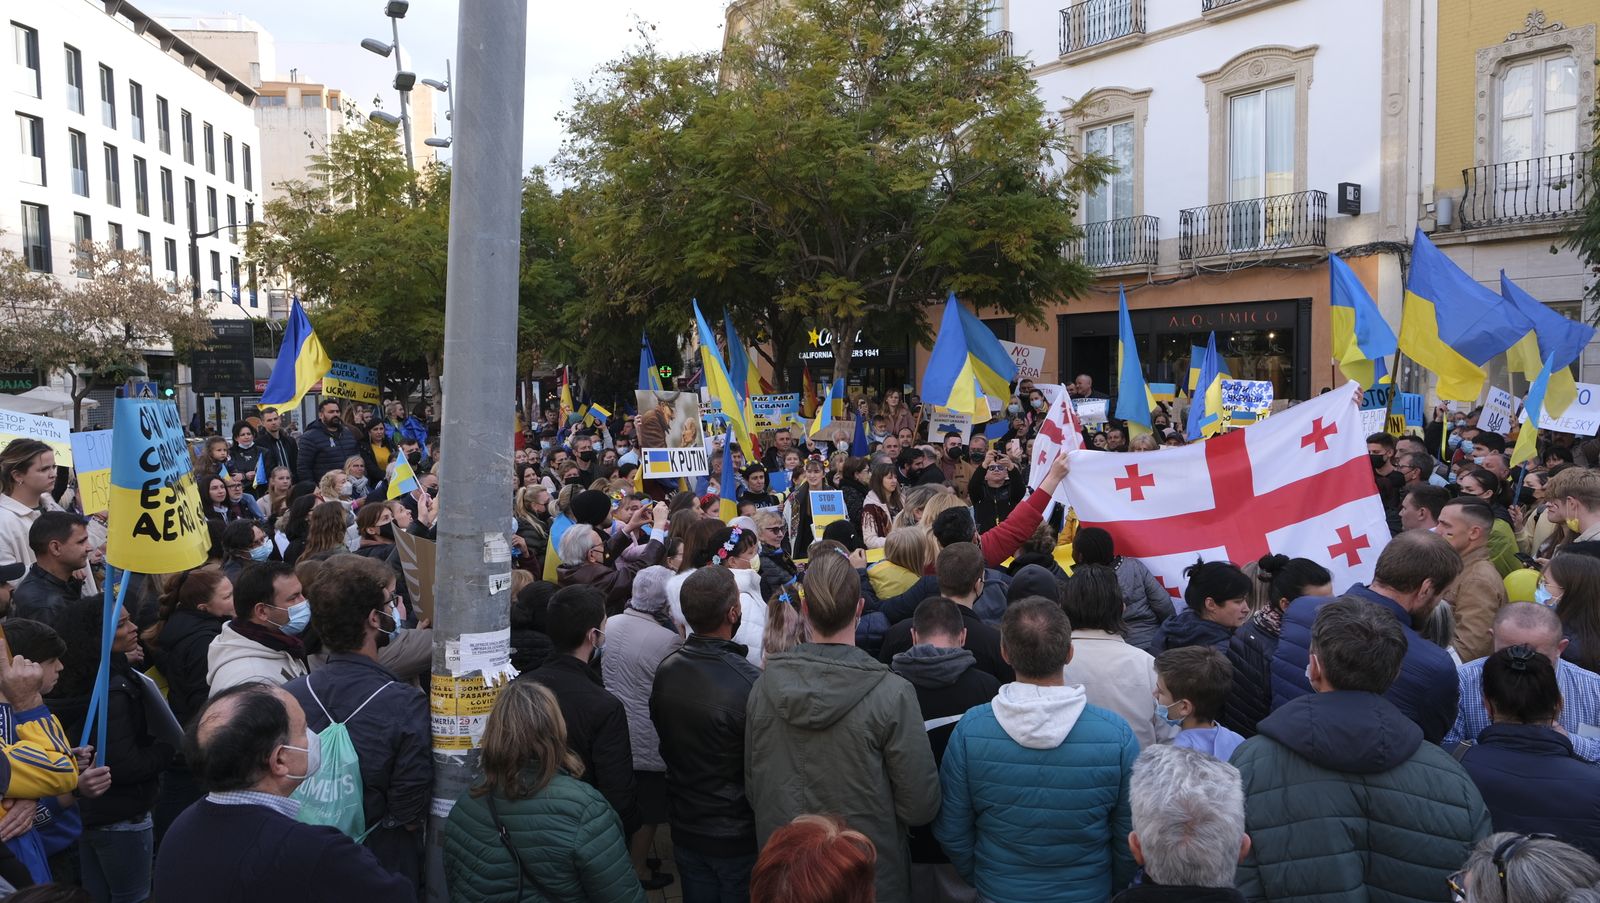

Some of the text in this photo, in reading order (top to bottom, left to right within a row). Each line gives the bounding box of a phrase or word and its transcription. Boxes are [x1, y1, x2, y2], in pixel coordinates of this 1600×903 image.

[1169, 312, 1277, 327] ALQUIMICO
[865, 349, 879, 357] 1941
[1012, 346, 1030, 358] NO
[33, 418, 55, 430] WAR
[30, 427, 62, 439] PUTIN
[678, 450, 706, 472] PUTIN
[818, 494, 835, 502] STOP
[820, 504, 835, 512] WAR
[460, 718, 470, 726] 29
